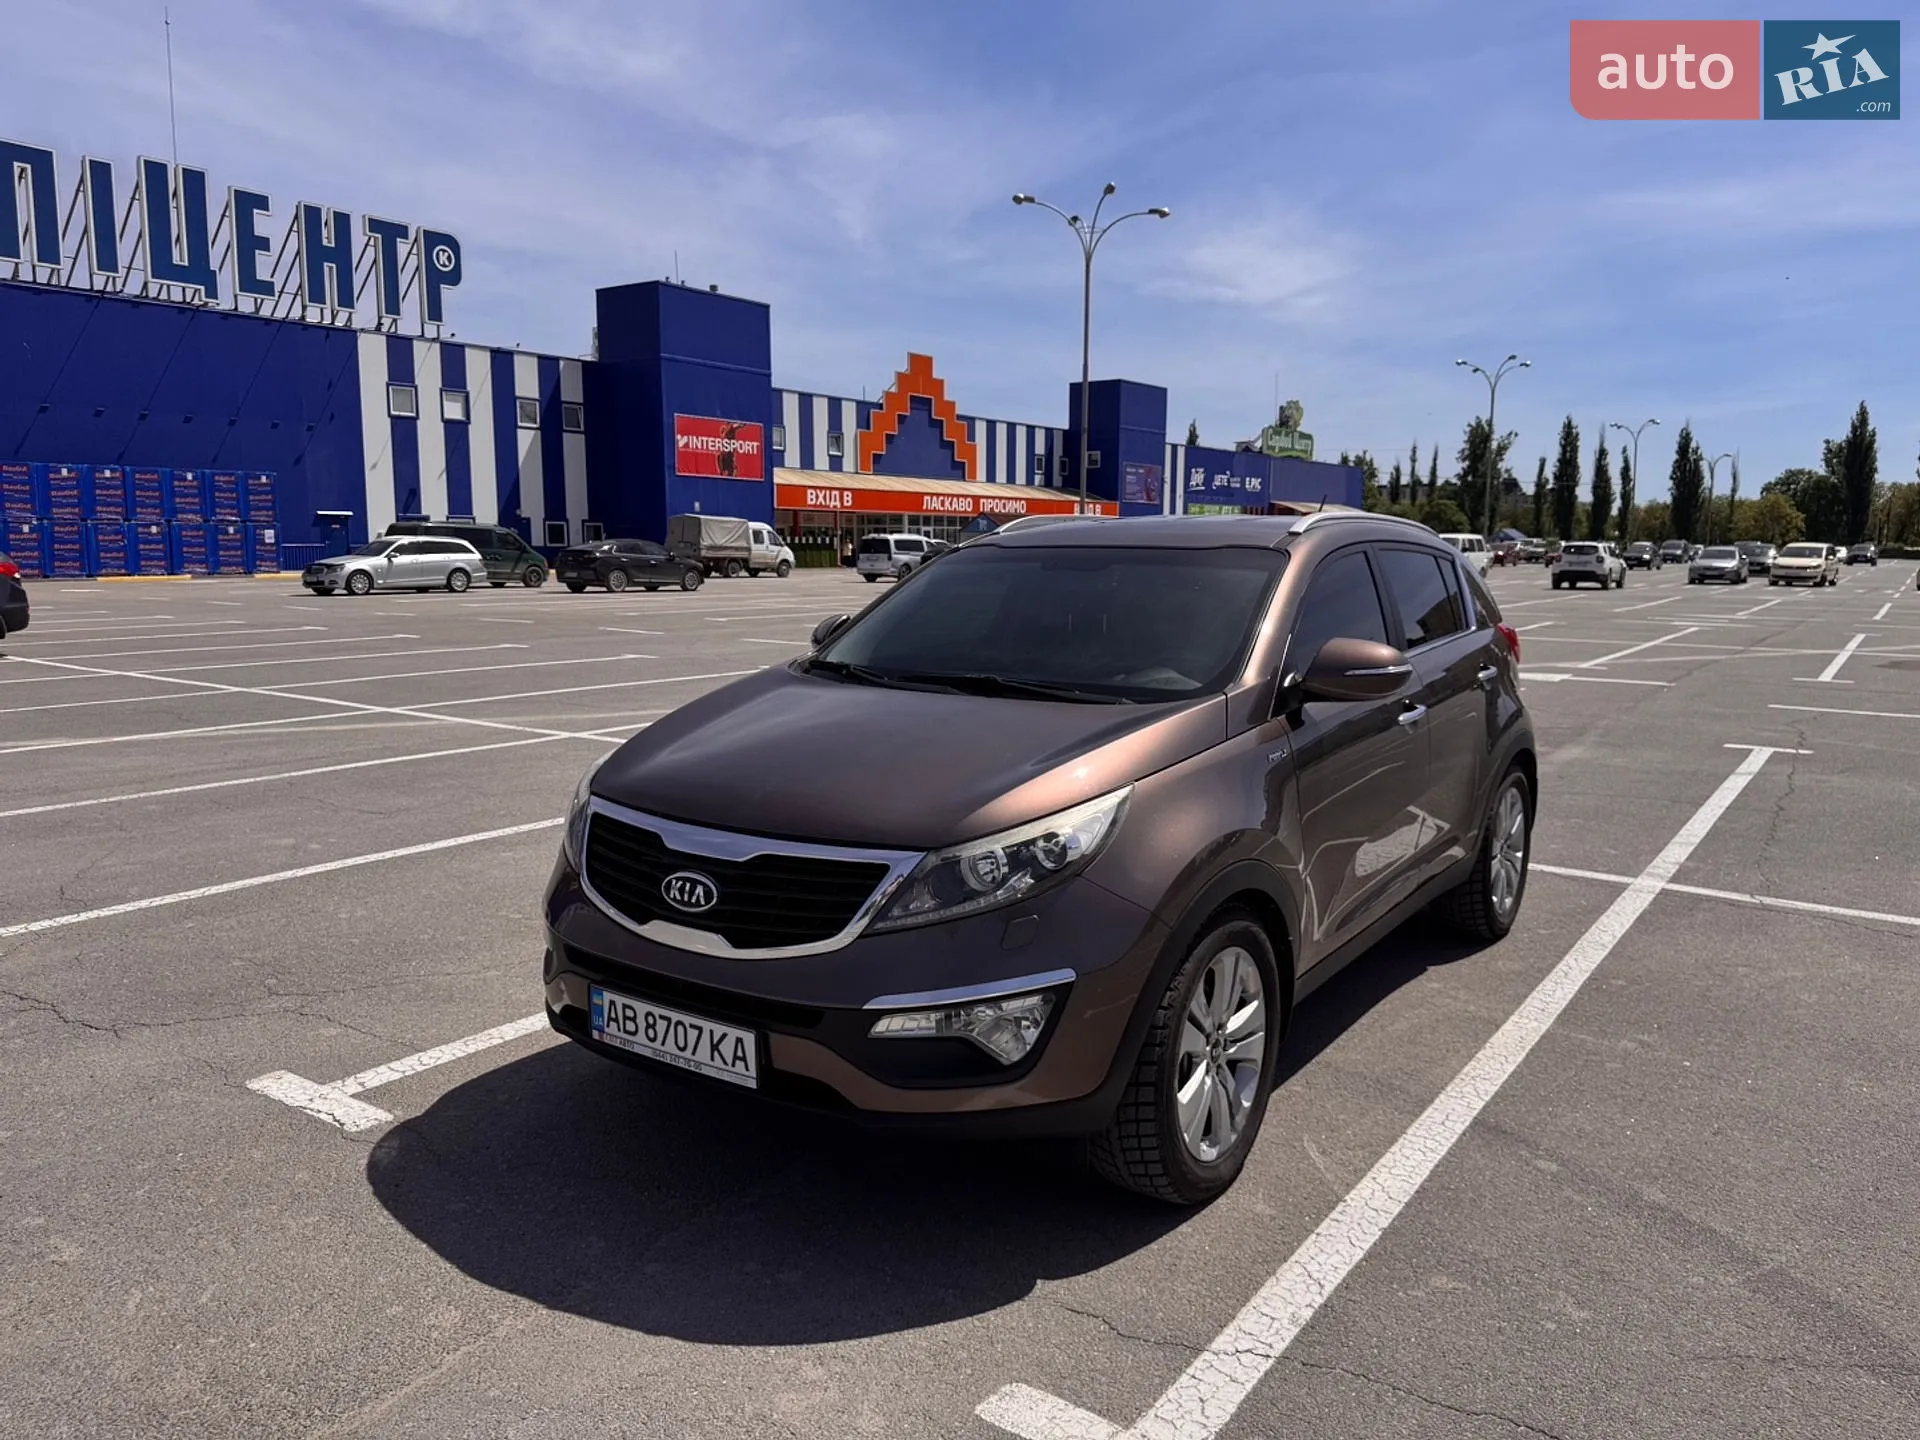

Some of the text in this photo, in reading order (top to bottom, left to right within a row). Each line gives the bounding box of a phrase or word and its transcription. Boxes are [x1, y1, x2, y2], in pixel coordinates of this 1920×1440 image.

[689, 435, 758, 455] INTERSPORT
[806, 488, 853, 508] ВХІД В
[922, 495, 1027, 514] ЛАСКАВО ПРОСИМО
[669, 879, 705, 905] KIA
[605, 998, 750, 1073] AB 8707 KA
